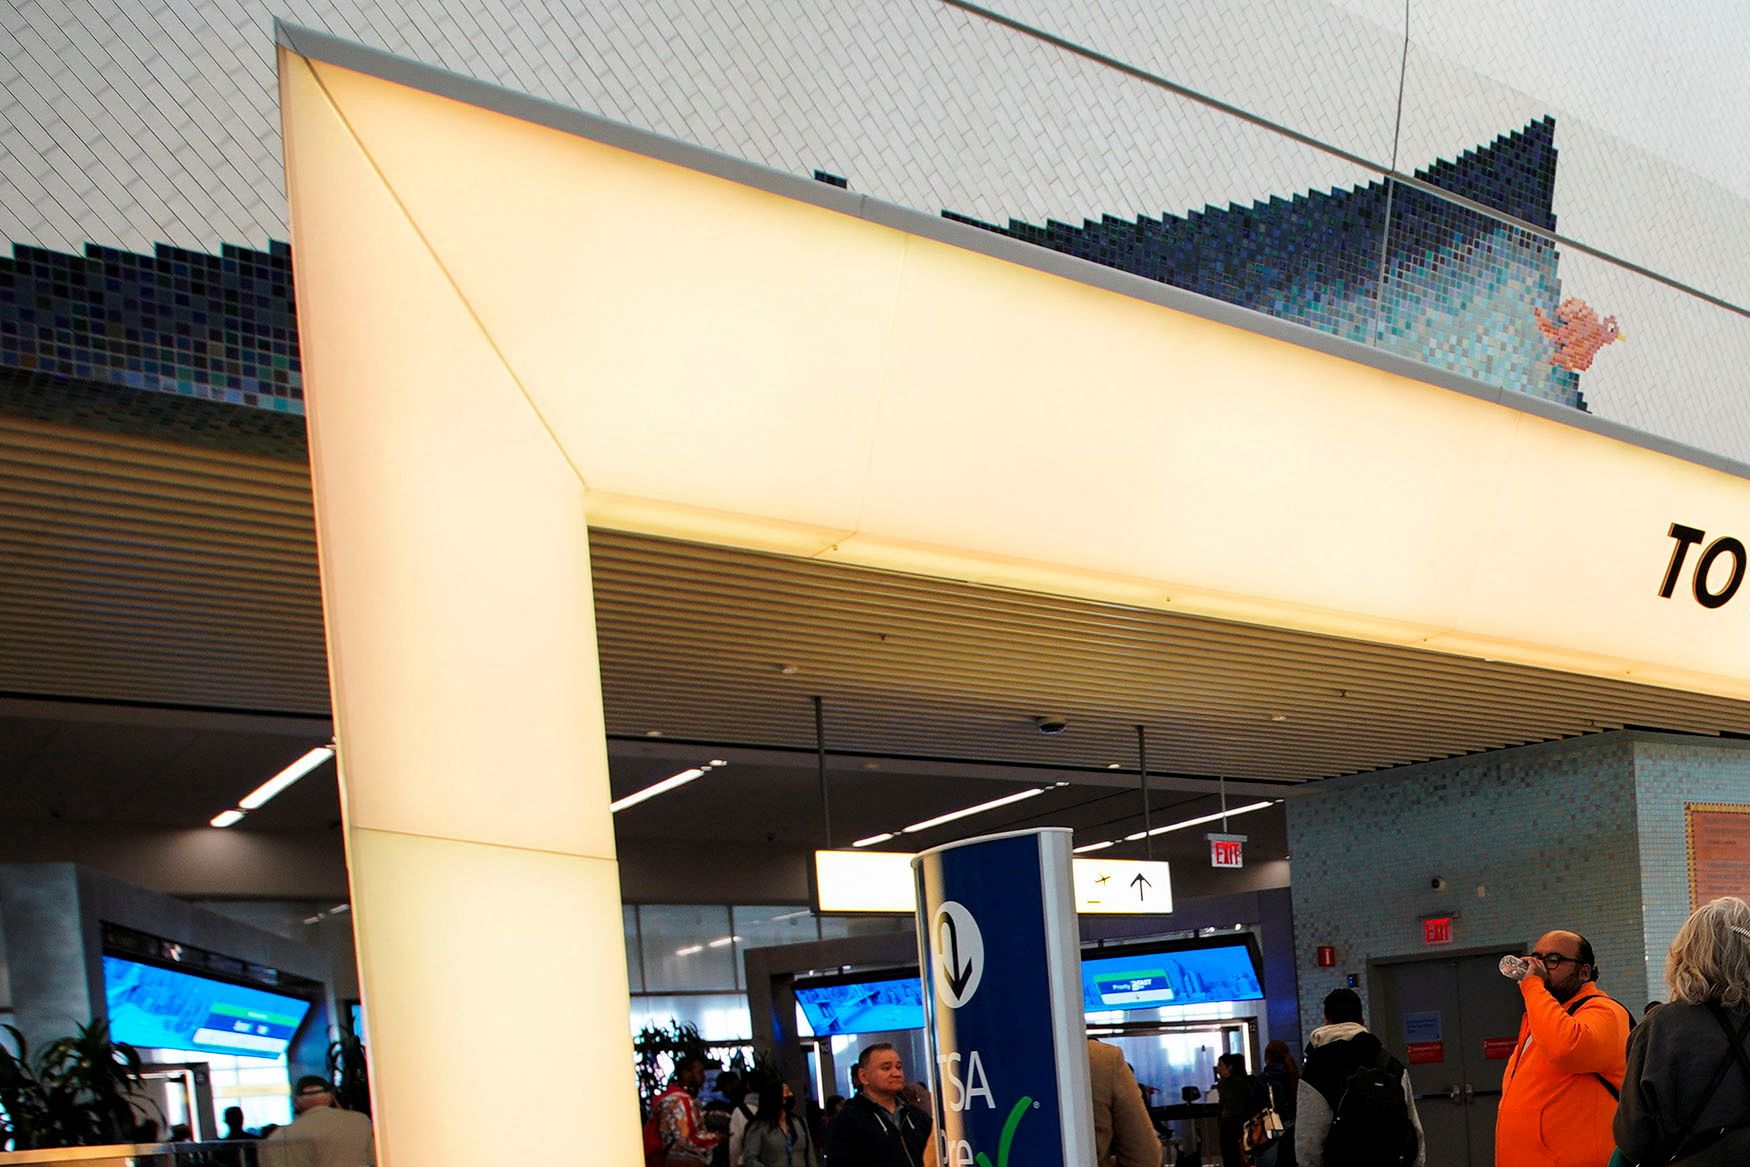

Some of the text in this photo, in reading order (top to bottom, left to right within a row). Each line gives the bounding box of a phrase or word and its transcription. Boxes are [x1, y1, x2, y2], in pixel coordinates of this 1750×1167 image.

[1658, 522, 1747, 609] TO
[1215, 841, 1241, 865] EXIT
[1425, 917, 1450, 942] EXIT
